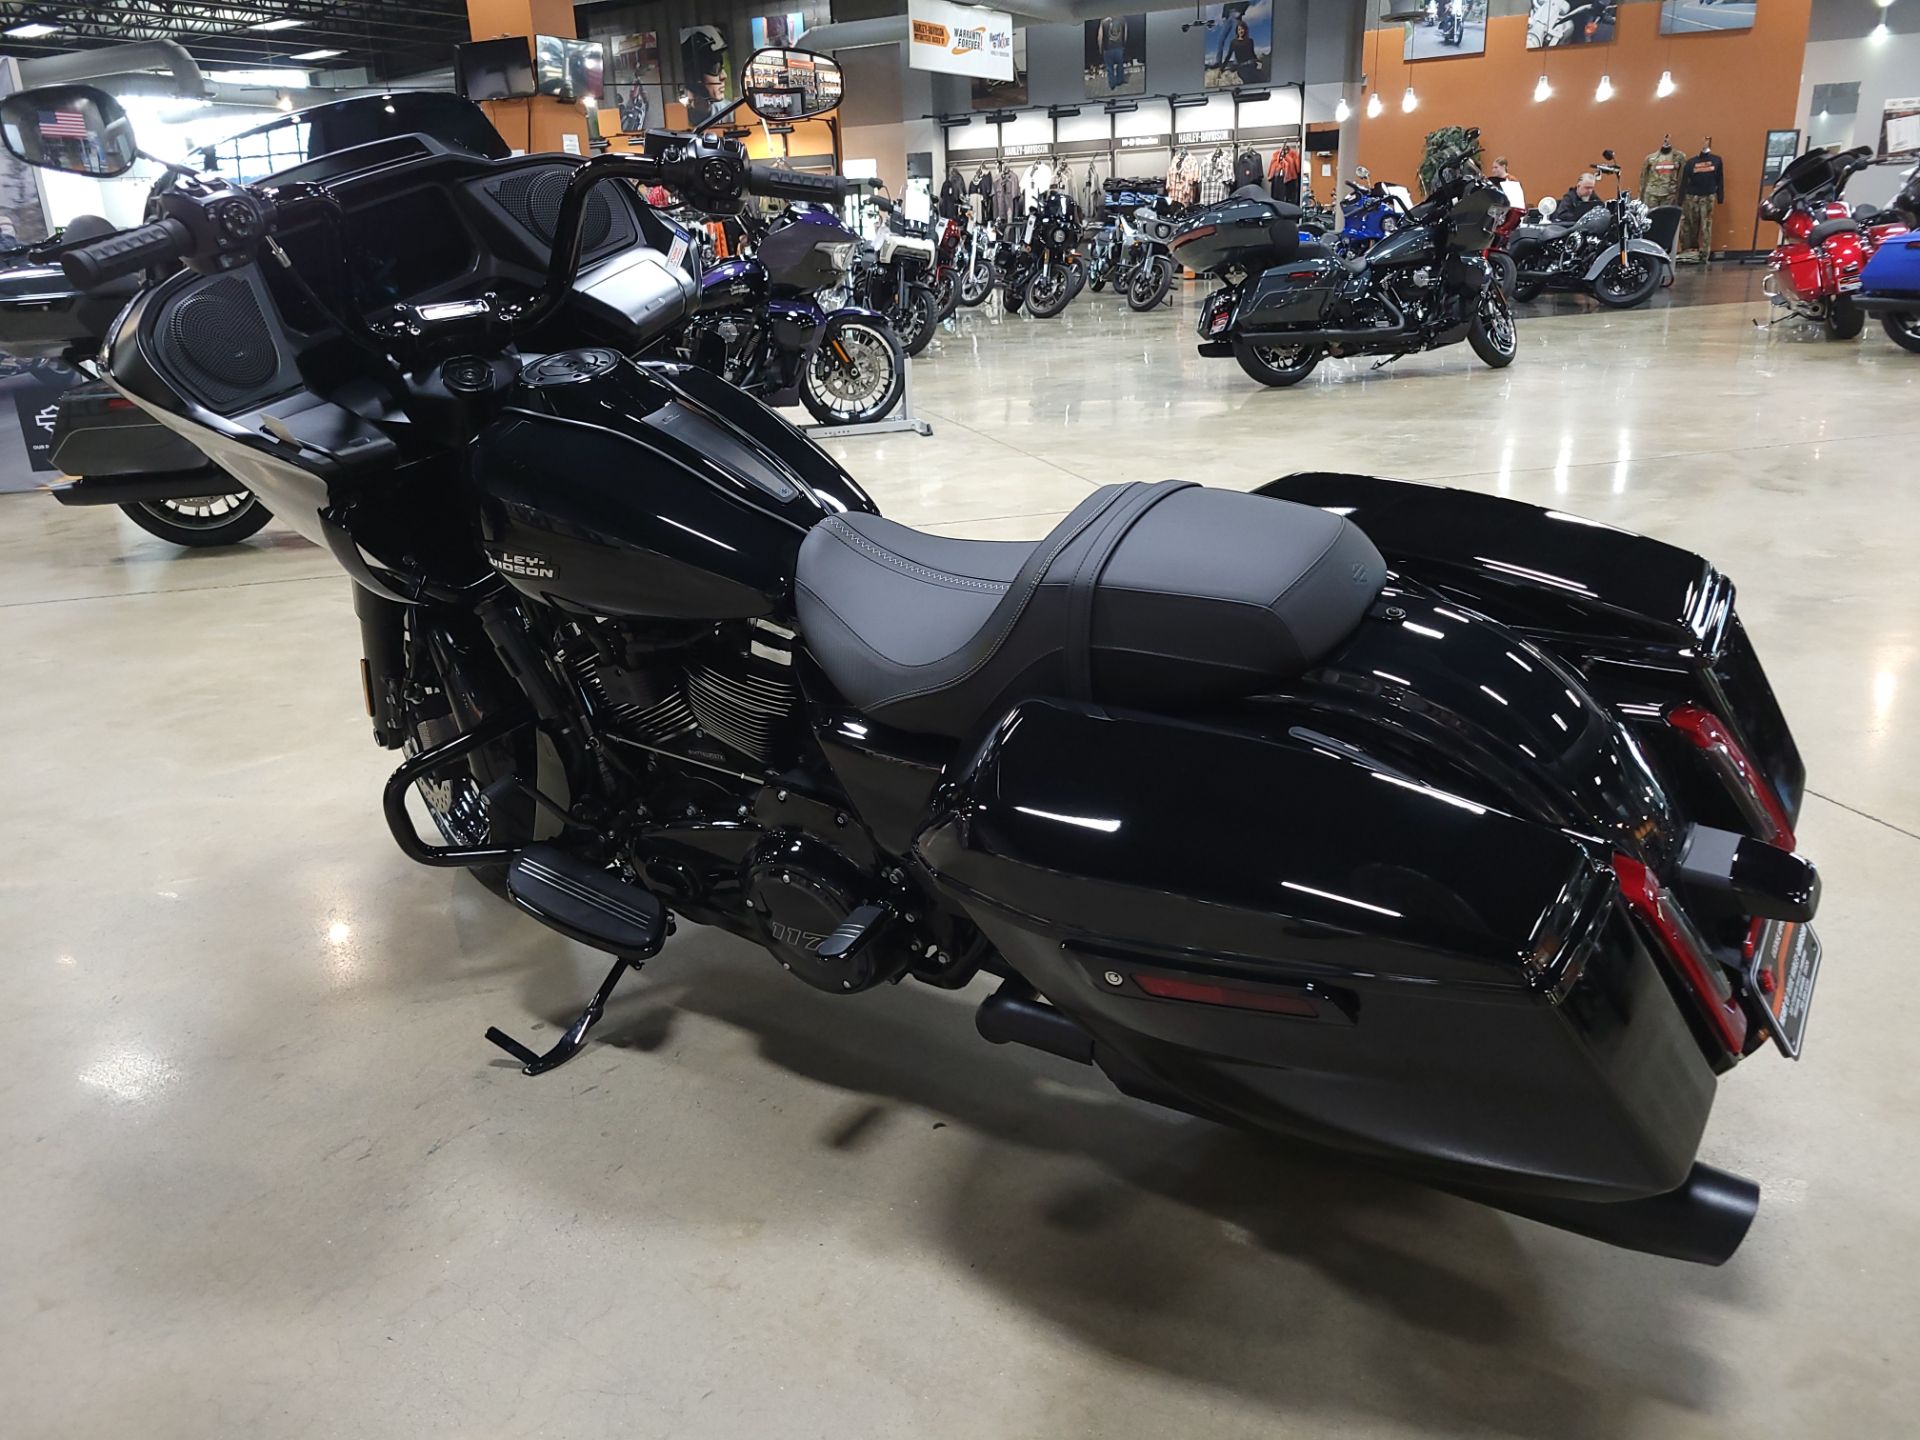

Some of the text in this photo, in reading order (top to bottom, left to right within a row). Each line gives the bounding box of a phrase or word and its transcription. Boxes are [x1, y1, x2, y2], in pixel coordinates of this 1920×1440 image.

[954, 27, 981, 40] WARRANTY
[957, 33, 984, 51] FOREVER!
[1179, 131, 1228, 144] HARLEY-DAVIDSON
[772, 921, 830, 951] 117
